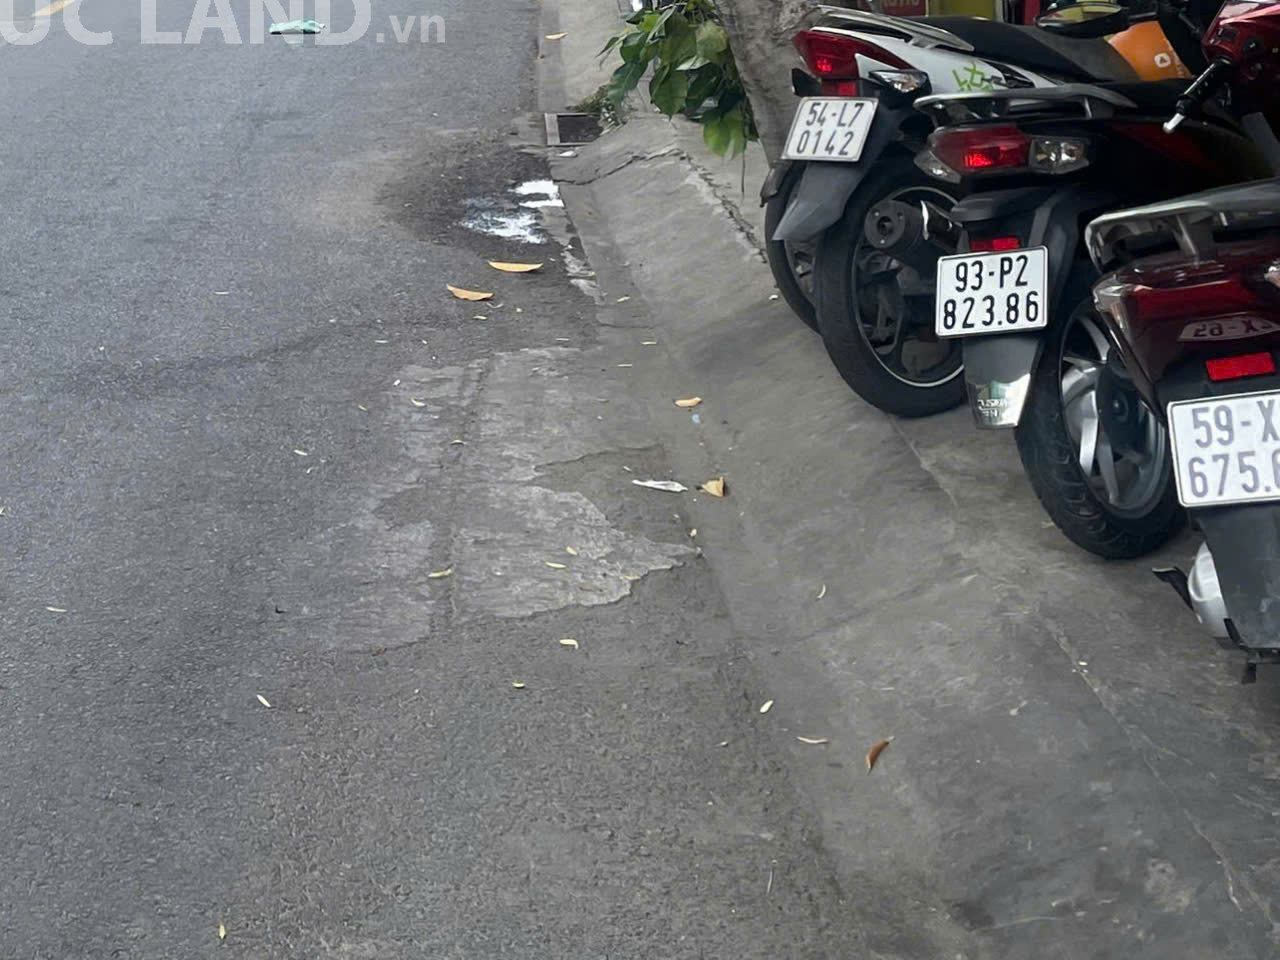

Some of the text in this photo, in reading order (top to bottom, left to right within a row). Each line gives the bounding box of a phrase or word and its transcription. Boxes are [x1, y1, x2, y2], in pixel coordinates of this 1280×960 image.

[806, 102, 864, 127] 54-L7
[796, 131, 854, 157] 0142
[954, 255, 1028, 292] 93-P2
[943, 291, 1039, 330] 823.86
[1191, 399, 1280, 448] 59-X
